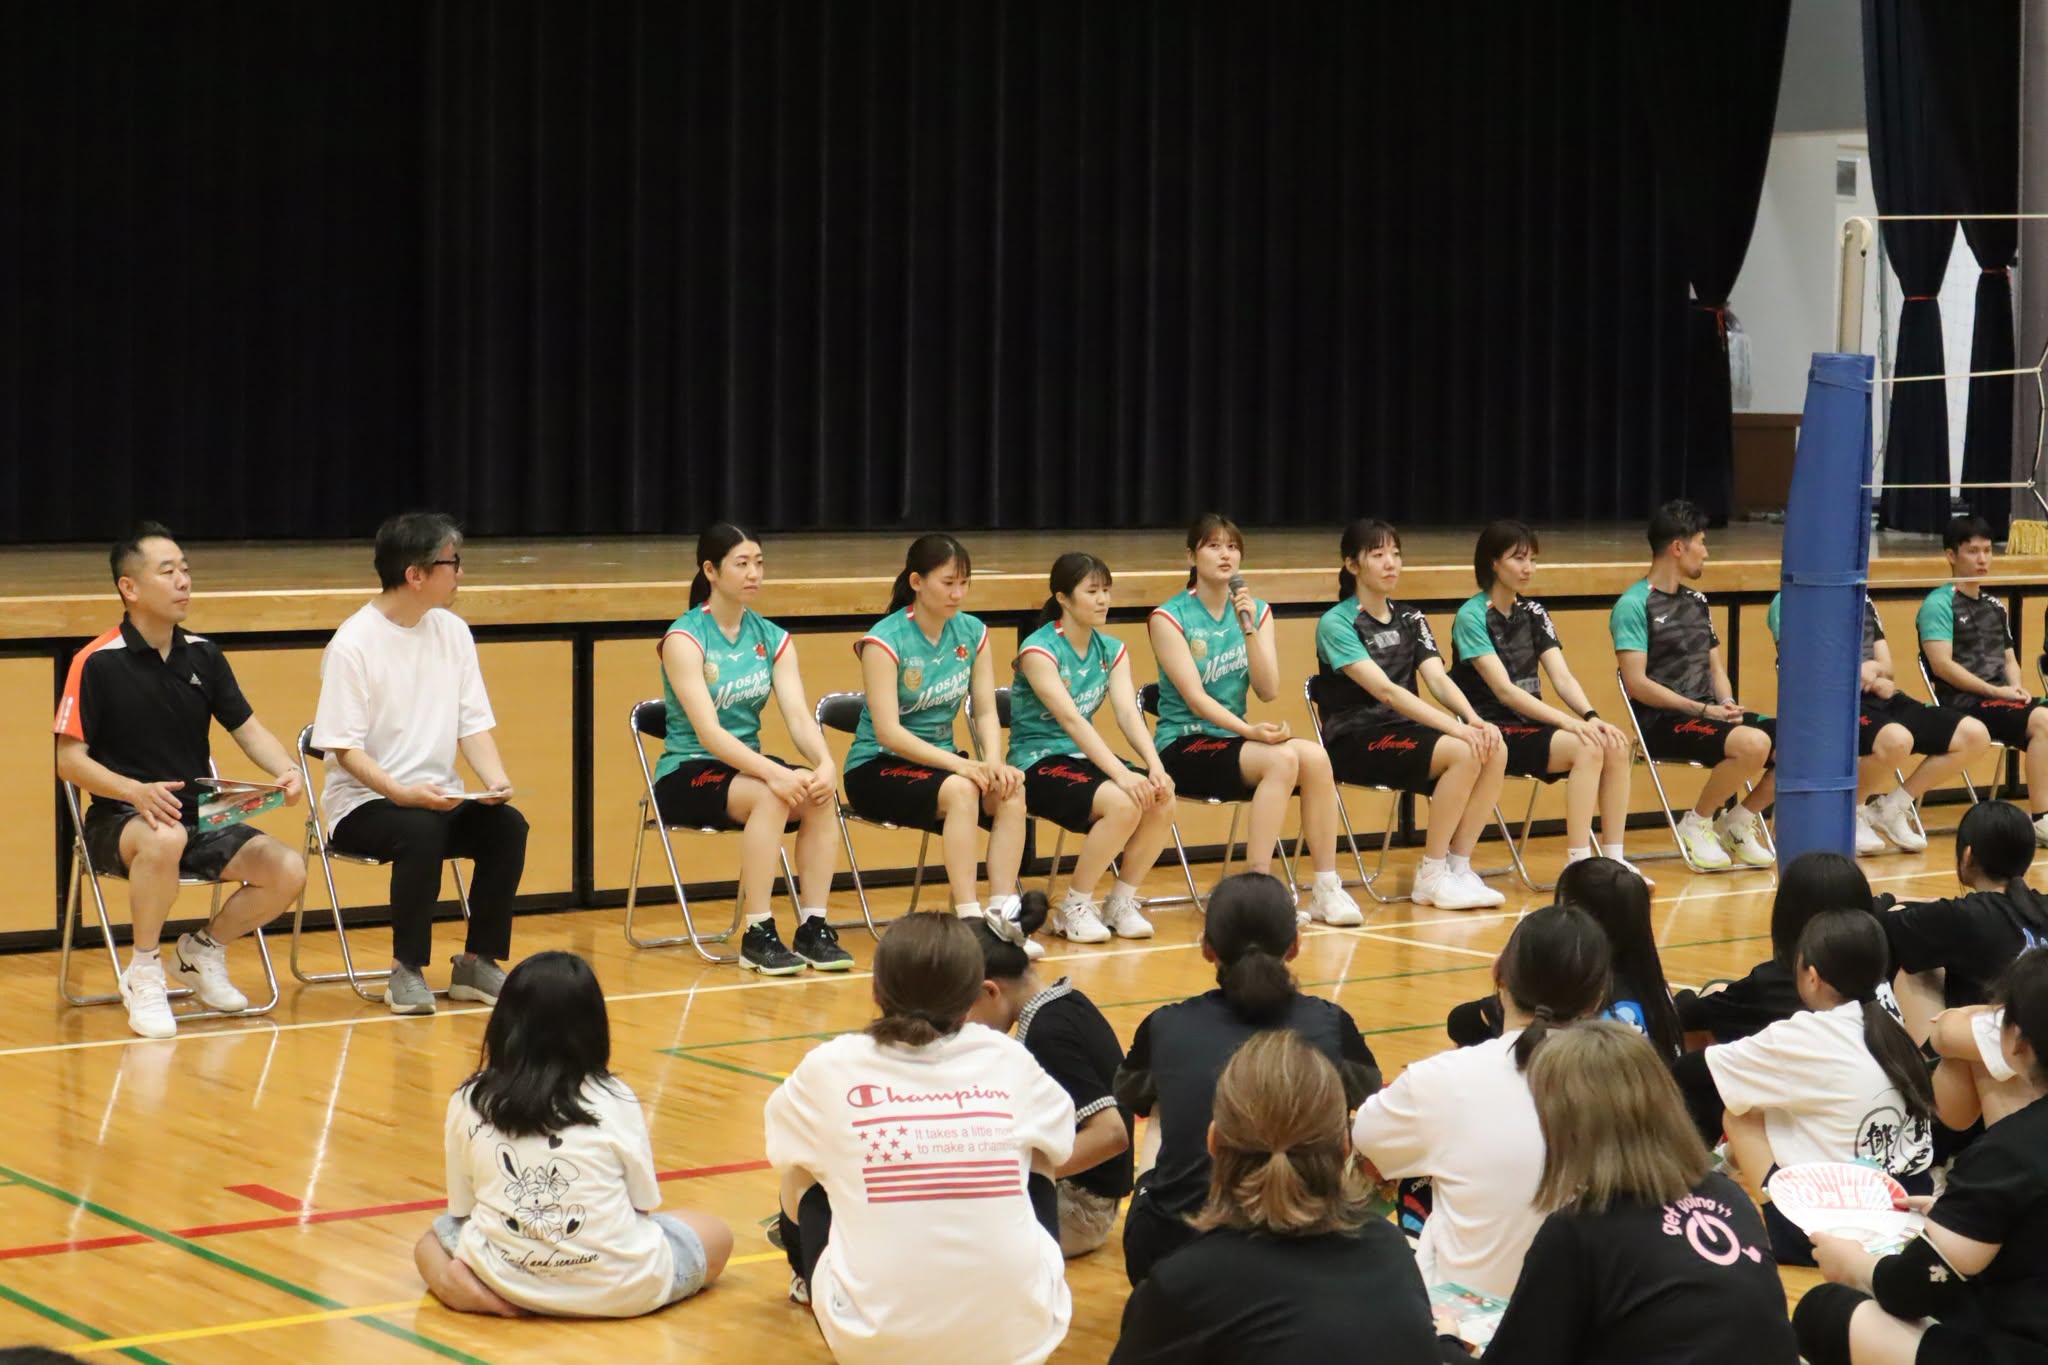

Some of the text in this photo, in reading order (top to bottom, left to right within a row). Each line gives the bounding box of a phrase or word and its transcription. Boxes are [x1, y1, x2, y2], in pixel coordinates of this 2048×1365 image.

[846, 1084, 1010, 1109] Champion
[925, 1128, 958, 1140] takes
[970, 1123, 993, 1137] little
[917, 1143, 929, 1155] to
[932, 1141, 965, 1154] make
[967, 1142, 976, 1153] a
[1662, 1204, 1683, 1236] get
